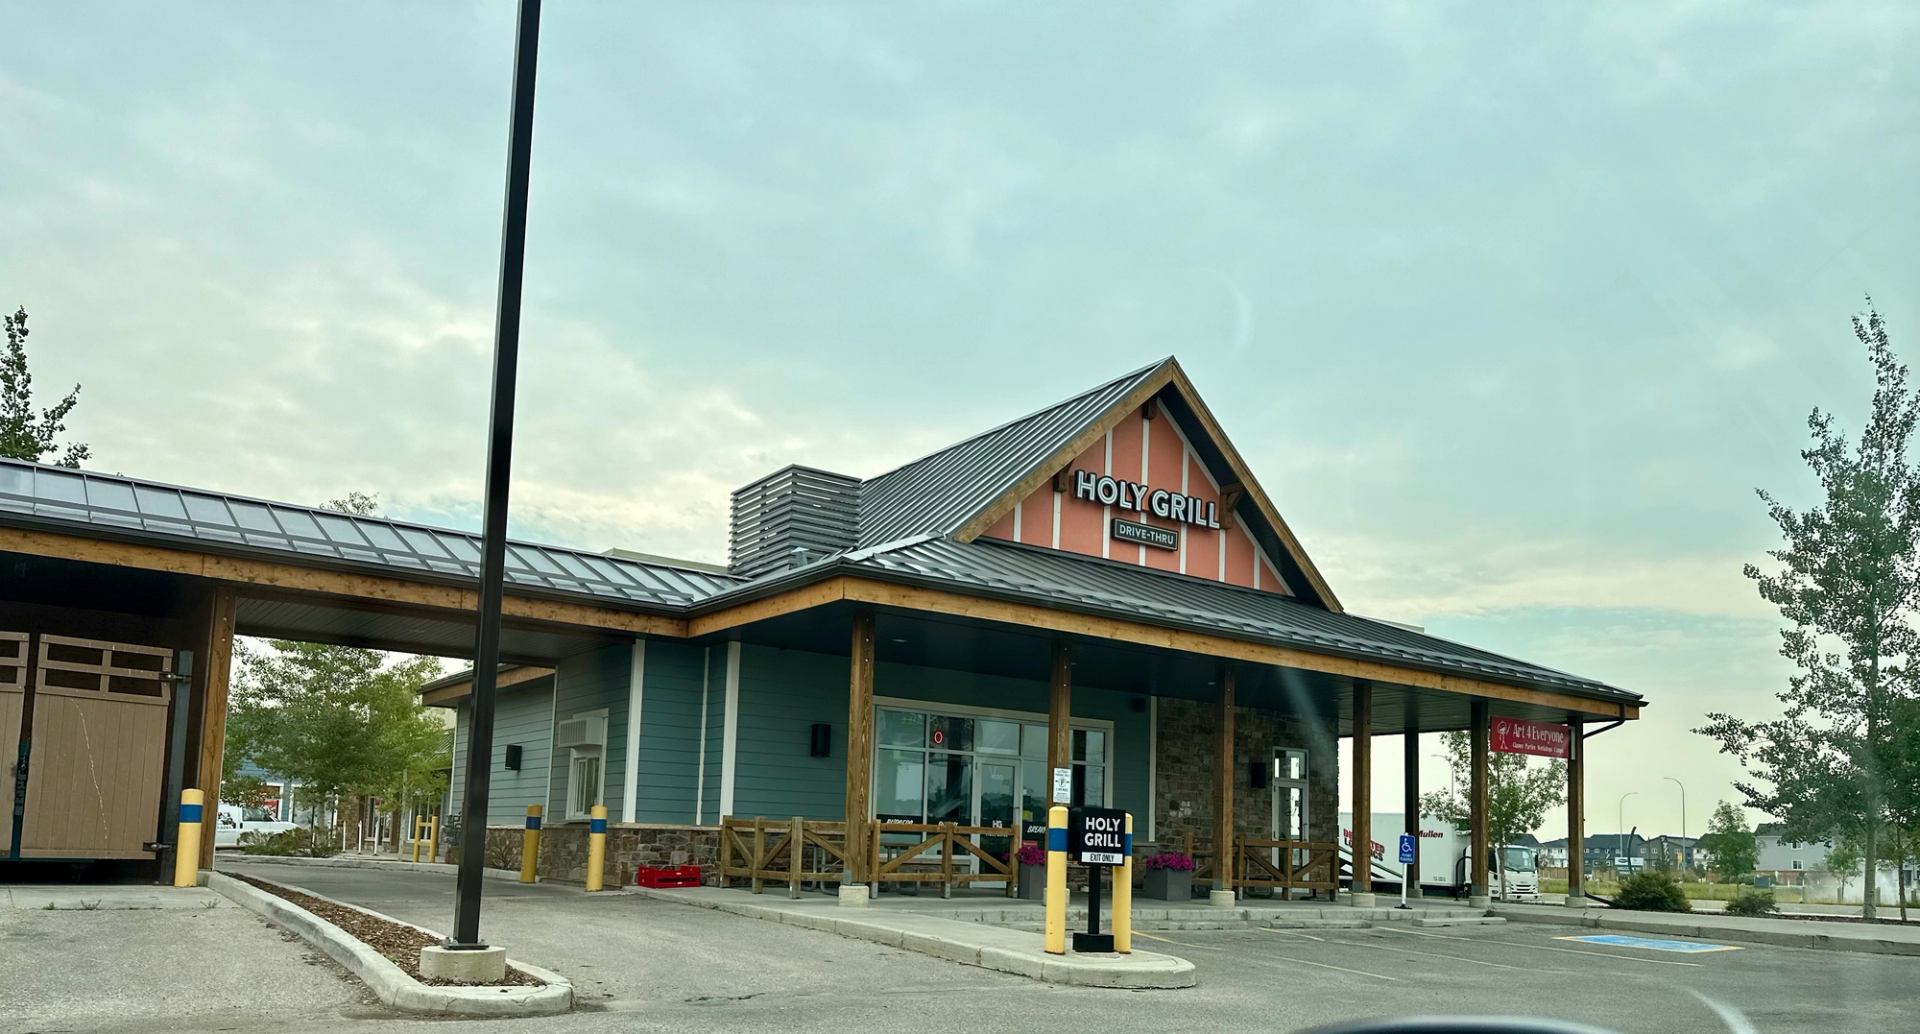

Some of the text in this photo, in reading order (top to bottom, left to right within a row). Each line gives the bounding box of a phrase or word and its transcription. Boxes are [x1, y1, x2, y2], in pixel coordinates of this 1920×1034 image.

[1075, 469, 1220, 529] HOLY GRILL
[1119, 524, 1174, 545] DRIVE-THRU
[1513, 724, 1564, 744] Art 4 Everyone
[1085, 816, 1121, 832] HOLY
[1084, 833, 1122, 848] GRILL
[1090, 854, 1115, 863] EXIT ONLY
